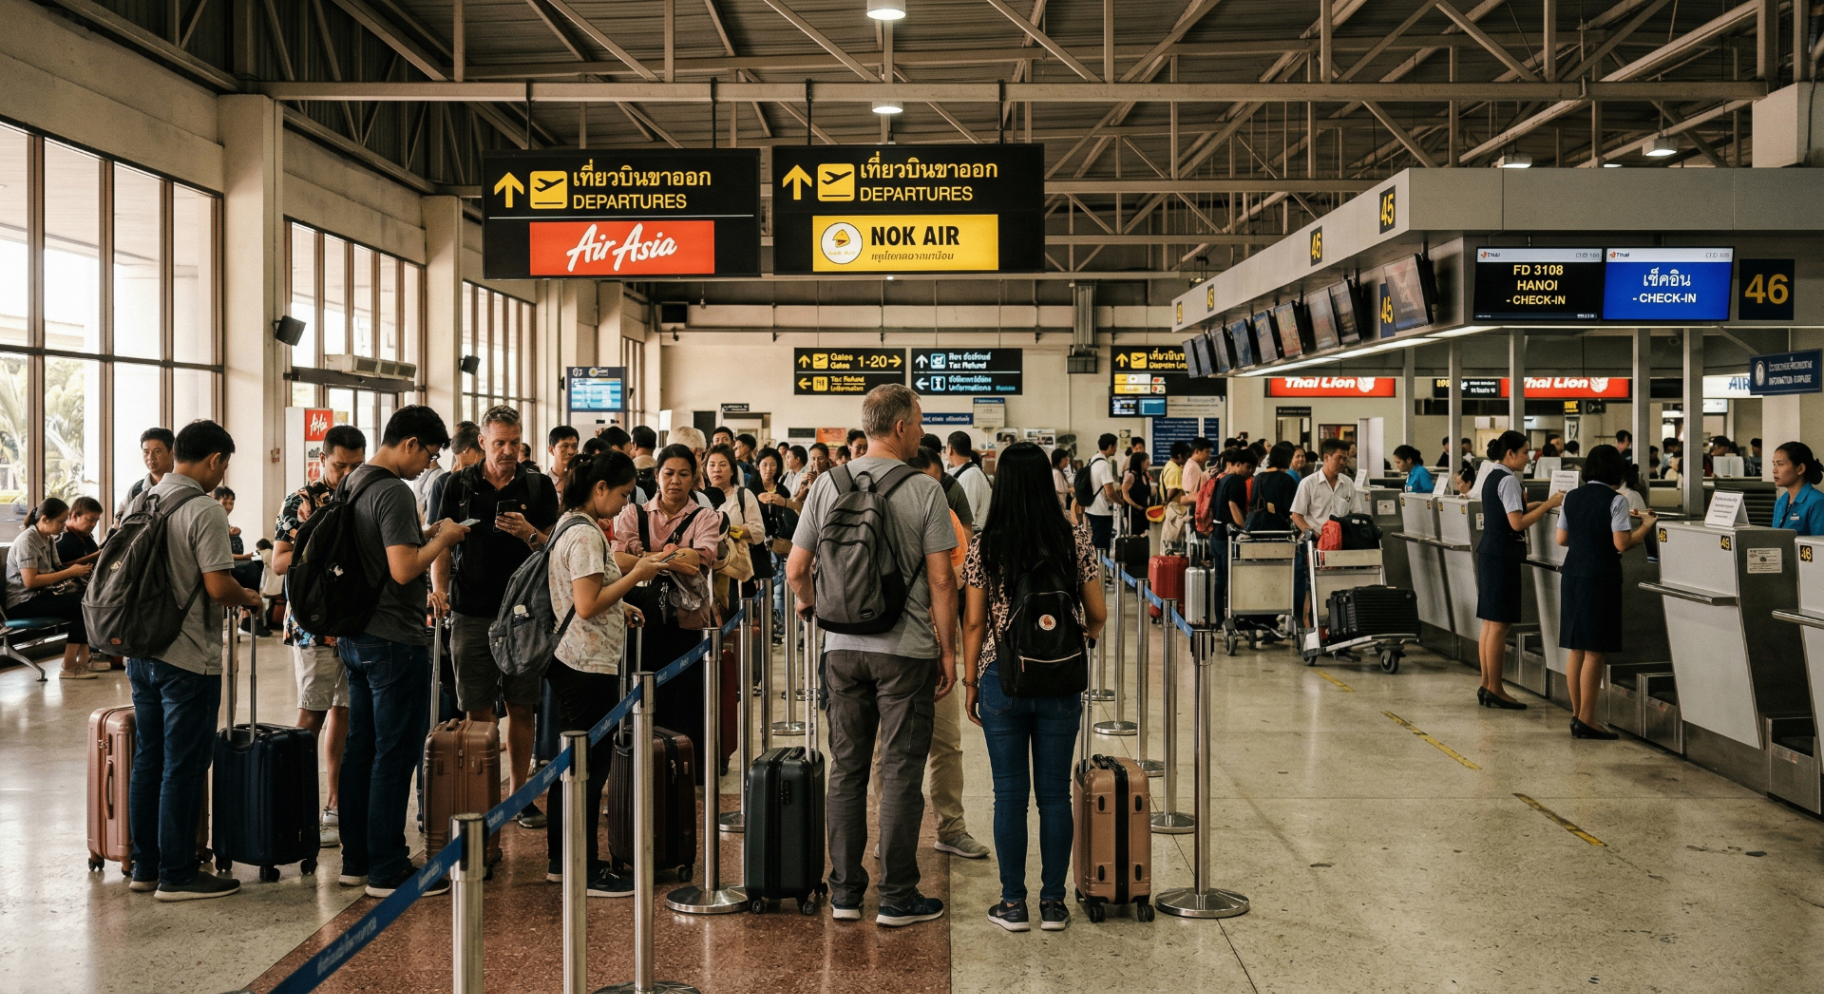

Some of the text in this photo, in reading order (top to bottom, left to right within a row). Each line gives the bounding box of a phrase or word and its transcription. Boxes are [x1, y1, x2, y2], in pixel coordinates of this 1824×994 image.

[860, 151, 998, 179] เที่ยวบินขาออก
[573, 159, 711, 187] เที่ยวบินขาออก
[860, 186, 973, 201] DEPARTURES
[573, 194, 687, 209] DEPARTURES
[1381, 193, 1394, 226] 45
[871, 225, 960, 246] NOK AIR
[1513, 265, 1564, 275] FD 3108
[1643, 267, 1691, 287] เช็คอิน
[1517, 280, 1558, 291] HANOI
[1745, 274, 1789, 304] 46
[1513, 295, 1566, 305] CHECK-IN
[1639, 293, 1697, 303] CHECK-IN
[1381, 296, 1394, 324] 45
[858, 355, 887, 368] 1-20
[1285, 377, 1356, 389] Thai Lion
[1553, 377, 1588, 389] Lion
